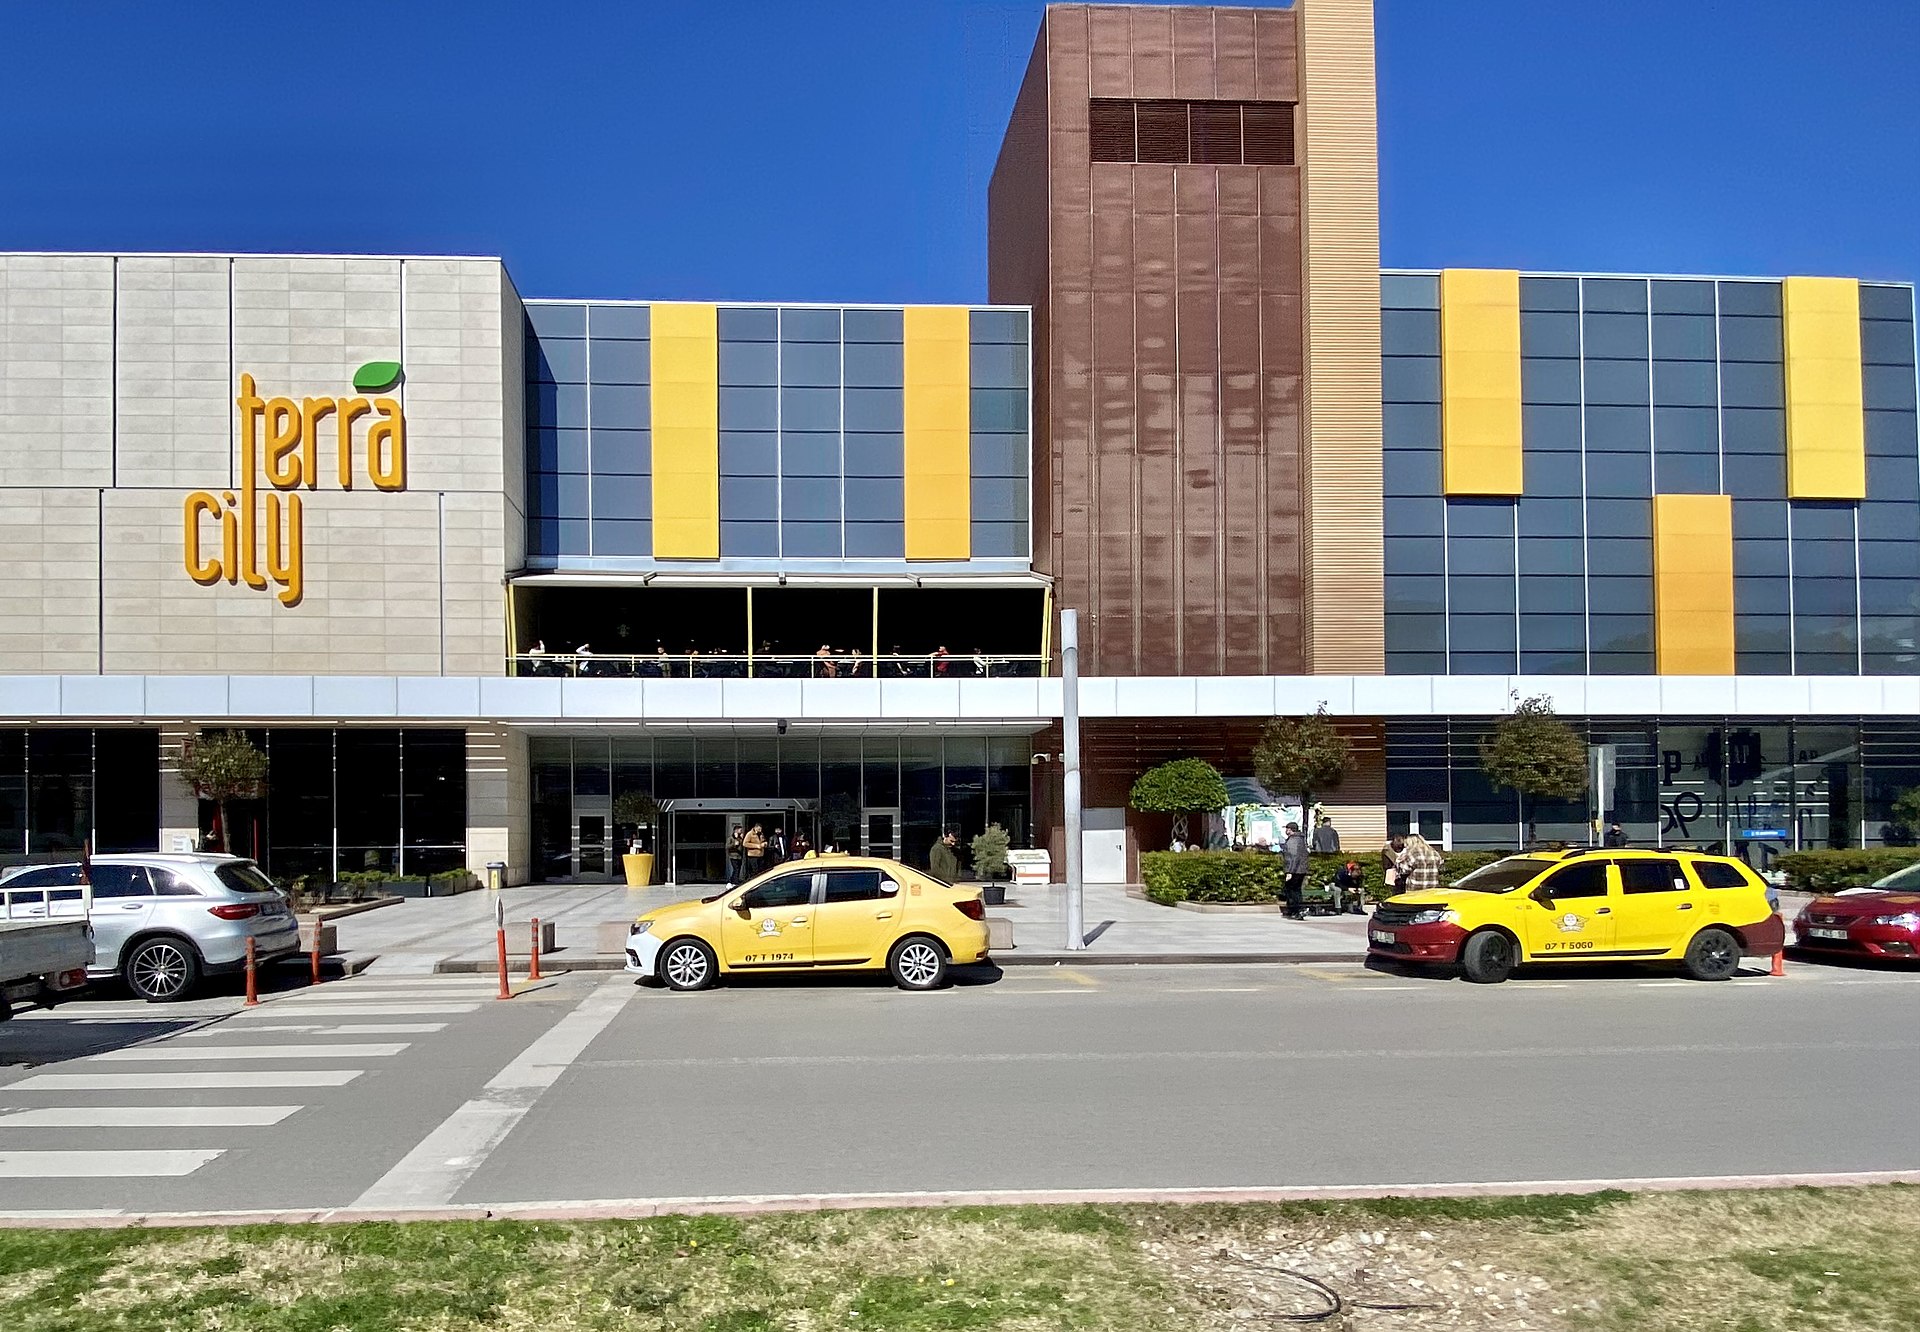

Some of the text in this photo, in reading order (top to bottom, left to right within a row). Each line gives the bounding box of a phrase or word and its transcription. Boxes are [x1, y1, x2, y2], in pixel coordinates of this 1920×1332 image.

[237, 373, 406, 491] terra
[185, 491, 303, 608] city
[745, 954, 758, 962] 07
[771, 953, 794, 961] 1974
[1545, 942, 1557, 950] 07
